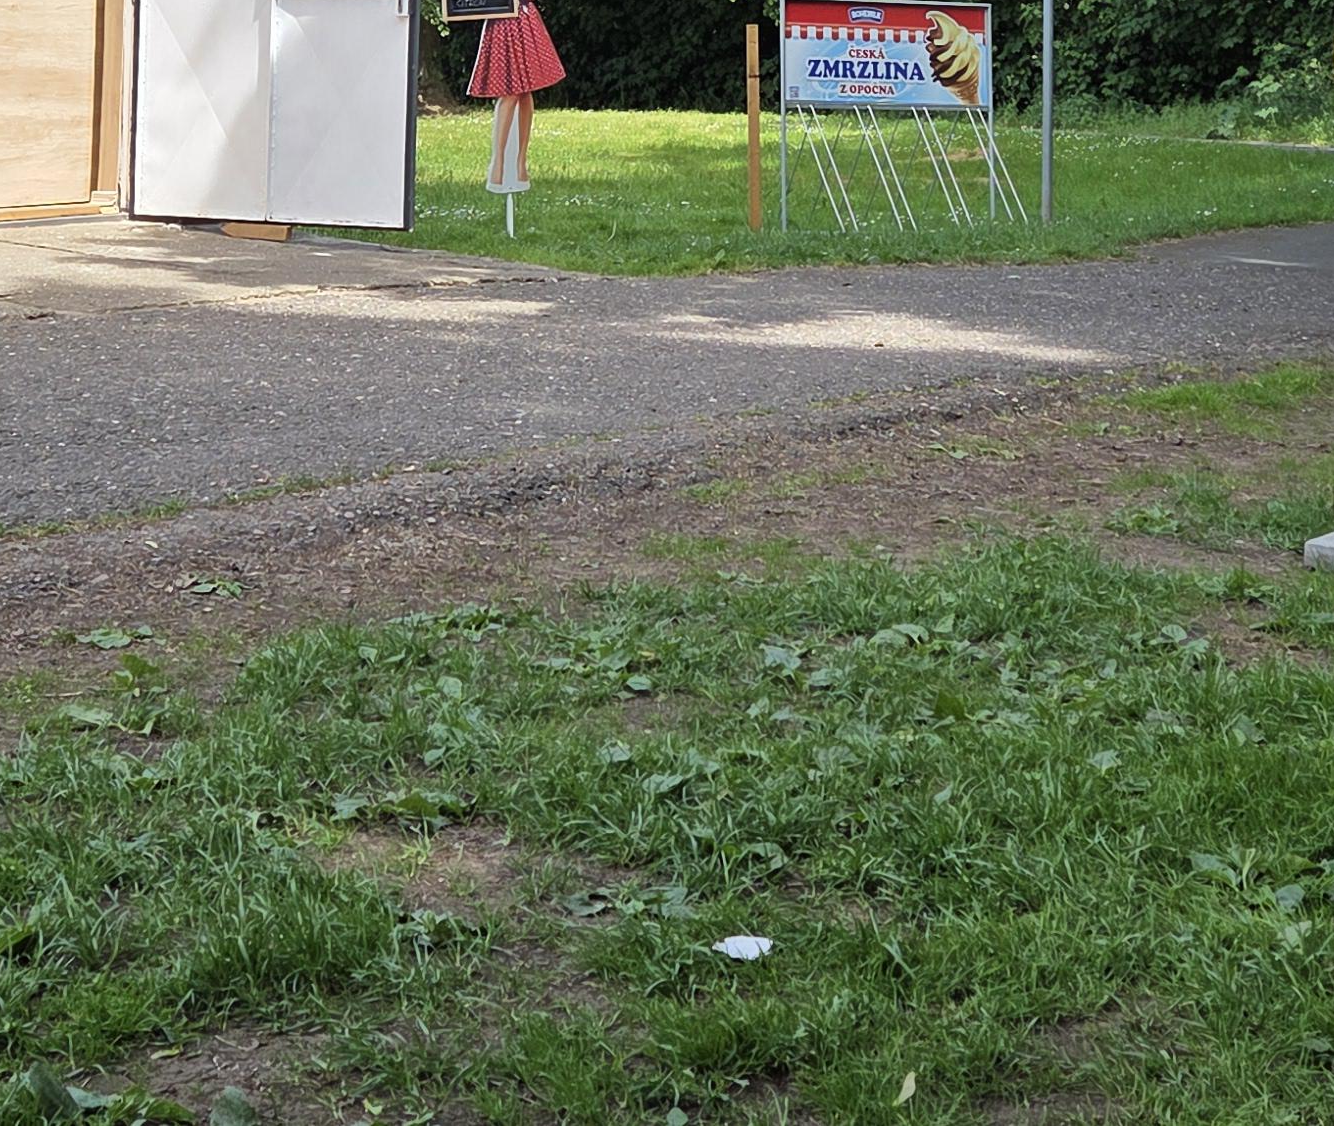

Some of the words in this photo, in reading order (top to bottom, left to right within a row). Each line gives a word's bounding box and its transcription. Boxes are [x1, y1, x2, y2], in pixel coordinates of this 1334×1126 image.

[848, 45, 885, 59] ČESKÁ
[807, 59, 925, 80] ZMRZLINA
[840, 85, 848, 93] Z
[849, 82, 895, 95] OPOČNA
